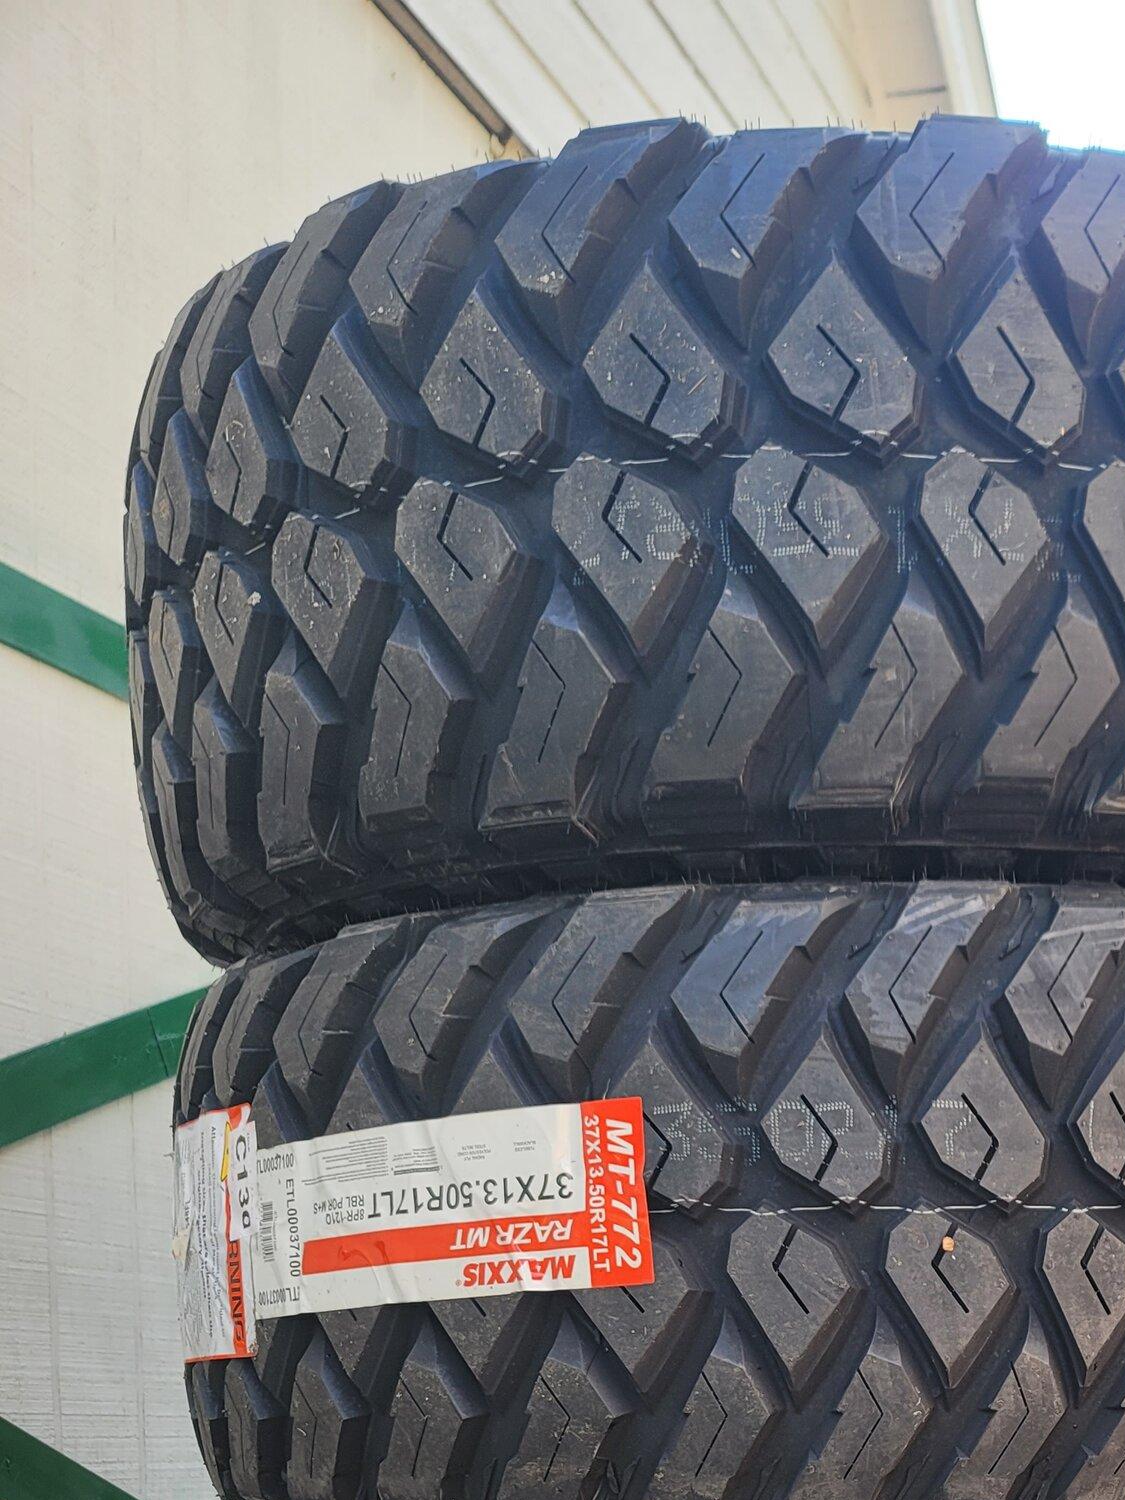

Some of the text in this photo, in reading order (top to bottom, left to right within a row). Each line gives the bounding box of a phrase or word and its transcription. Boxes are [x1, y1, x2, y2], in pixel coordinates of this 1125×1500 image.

[345, 1195, 365, 1207] RBL
[367, 1172, 574, 1219] 37X13.50R17LT
[584, 1114, 611, 1273] 37X13.50R17LT
[605, 1118, 642, 1269] MT-772
[286, 1178, 301, 1277] ETL00037100
[450, 1218, 573, 1250] RAZR MT
[463, 1254, 576, 1287] MAXXIS
